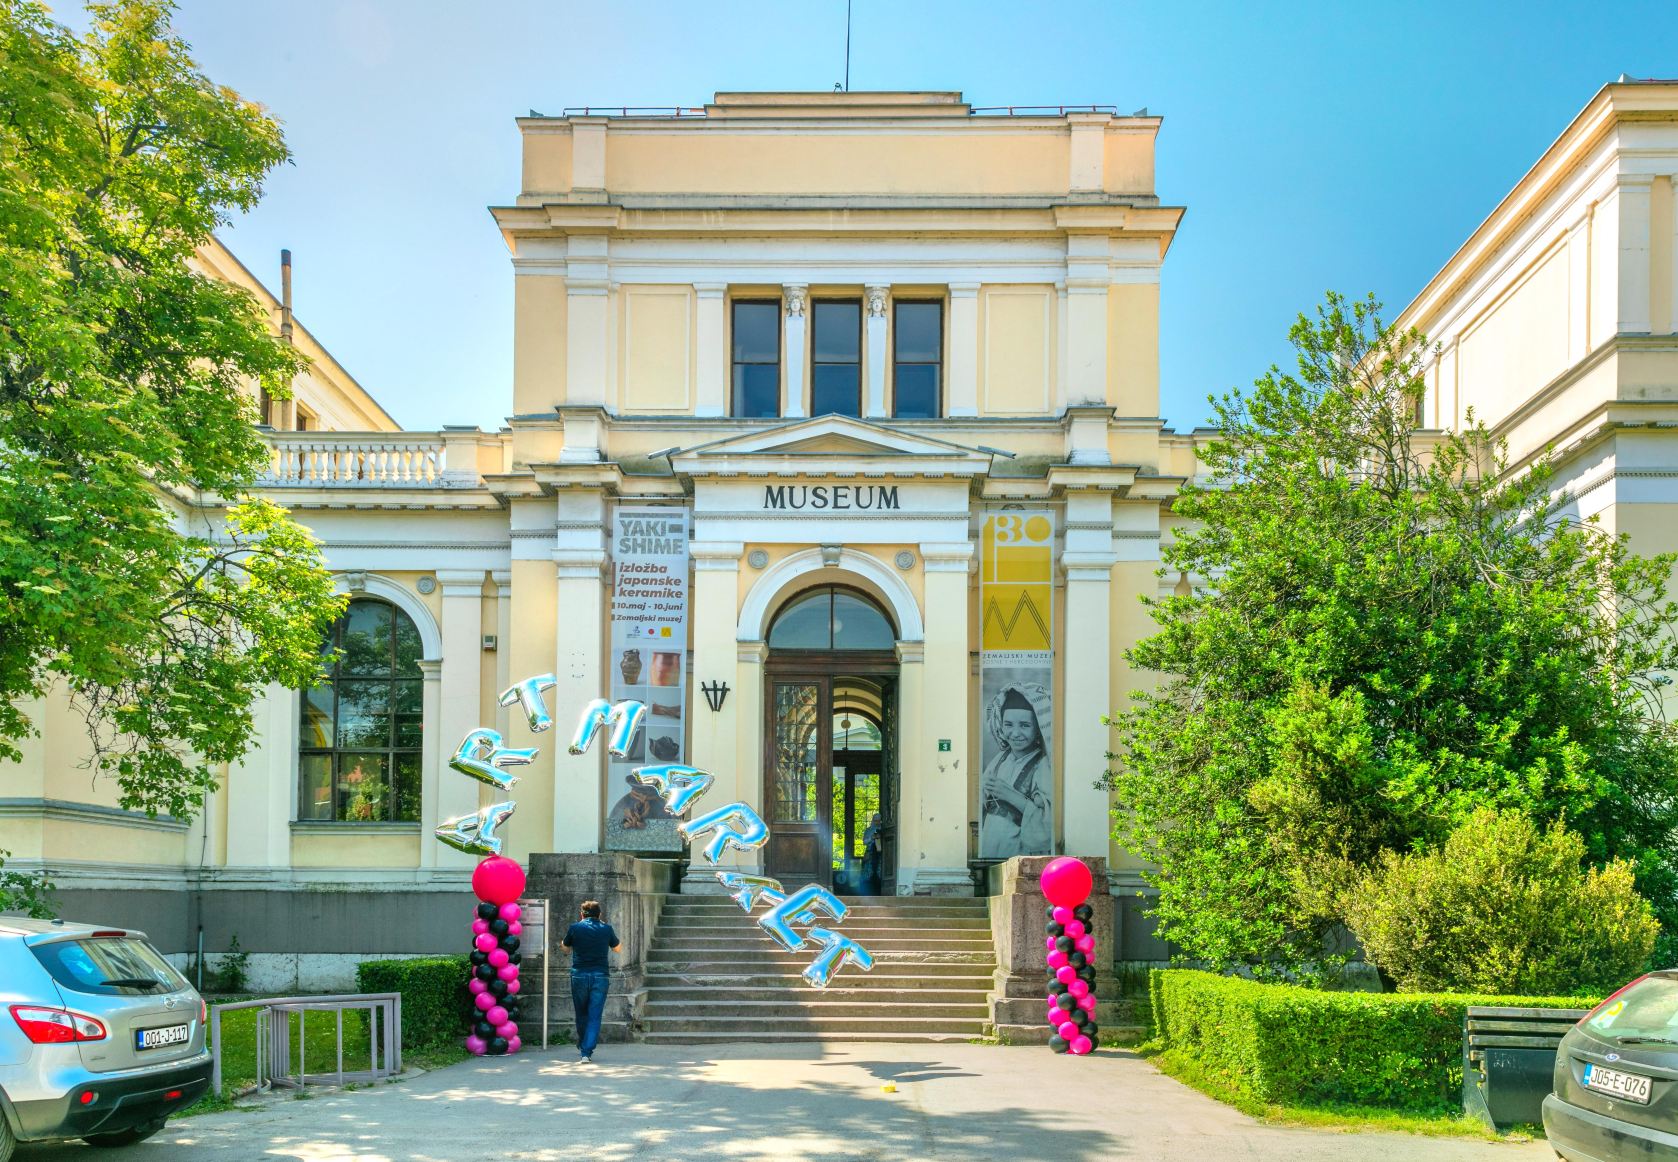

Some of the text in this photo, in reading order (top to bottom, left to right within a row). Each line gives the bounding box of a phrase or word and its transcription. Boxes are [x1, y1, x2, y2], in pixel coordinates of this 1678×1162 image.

[763, 485, 900, 509] MUSEUM
[619, 538, 684, 555] SHIME
[619, 562, 668, 574] izložba
[617, 574, 682, 587] japanske
[618, 587, 683, 599] keramike
[617, 602, 647, 610] 10.maj
[654, 603, 683, 611] 10.juni
[616, 614, 683, 623] Zemaljski muzej
[1590, 1068, 1647, 1096] J05-E-076
